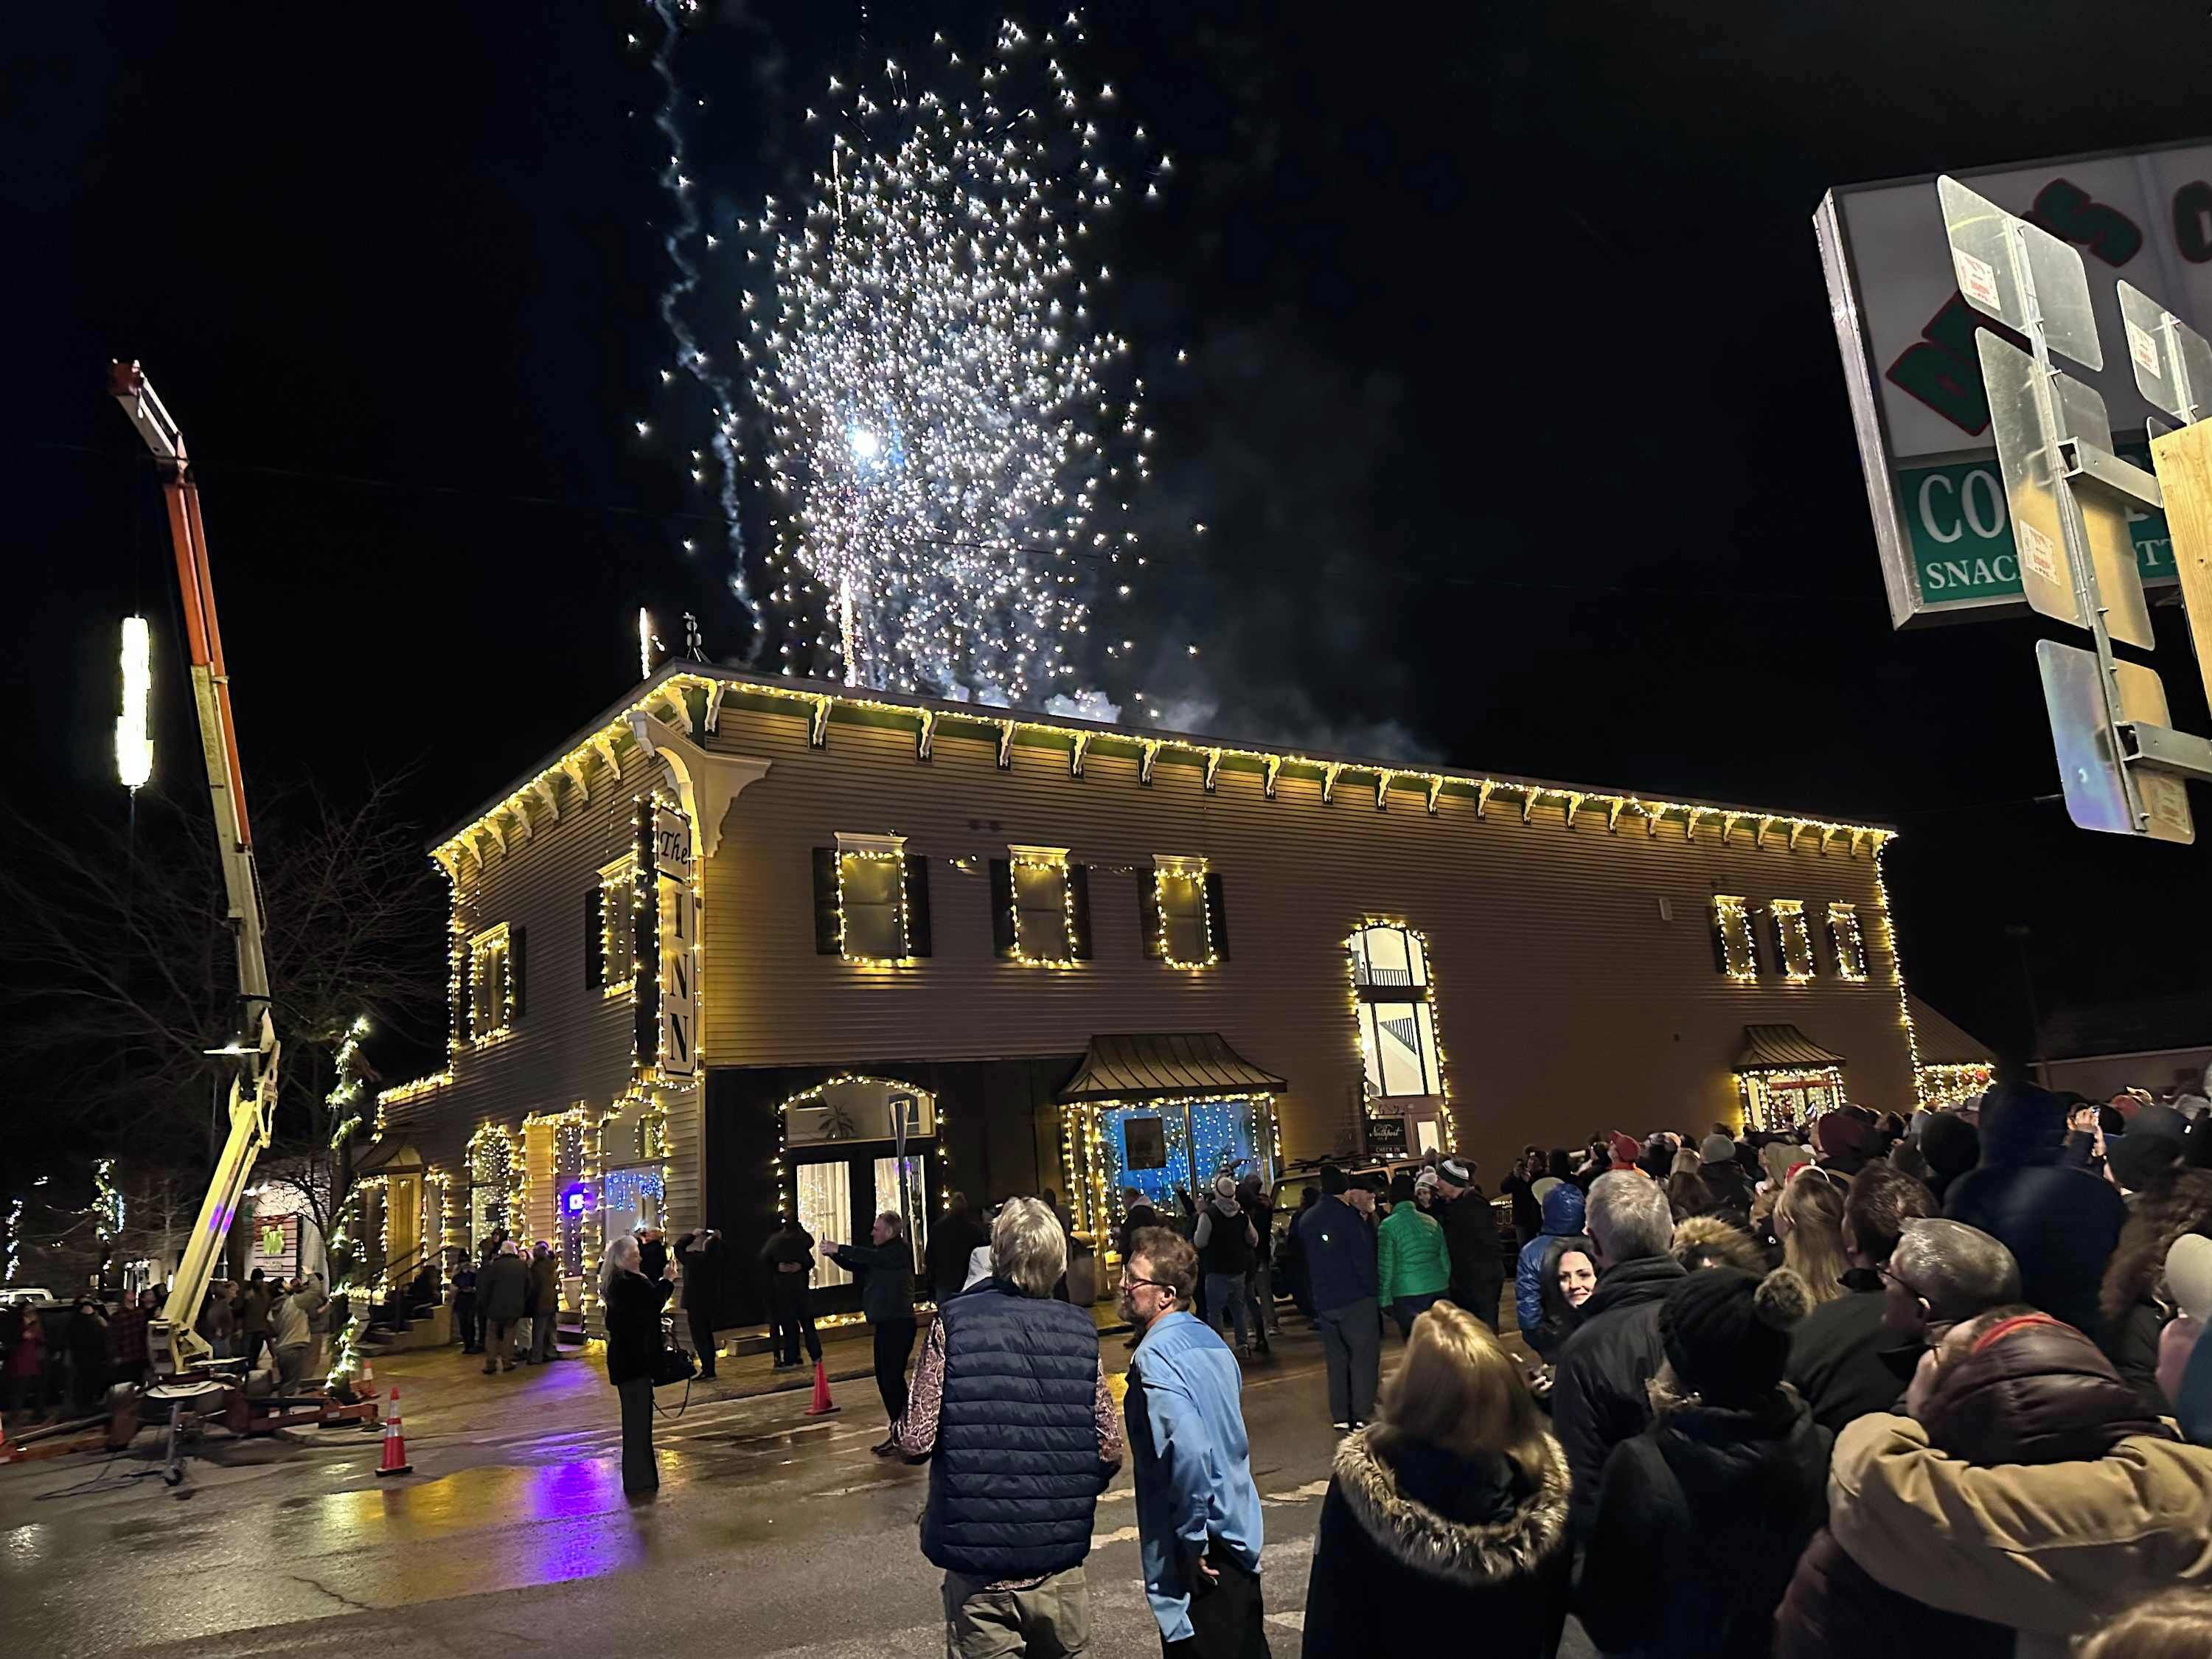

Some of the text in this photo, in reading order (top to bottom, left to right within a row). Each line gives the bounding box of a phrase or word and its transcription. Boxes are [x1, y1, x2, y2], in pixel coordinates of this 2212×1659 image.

[1919, 470, 2006, 543] CO
[1926, 555, 2020, 588] SNAC
[661, 831, 687, 865] The
[669, 891, 689, 1062] INN
